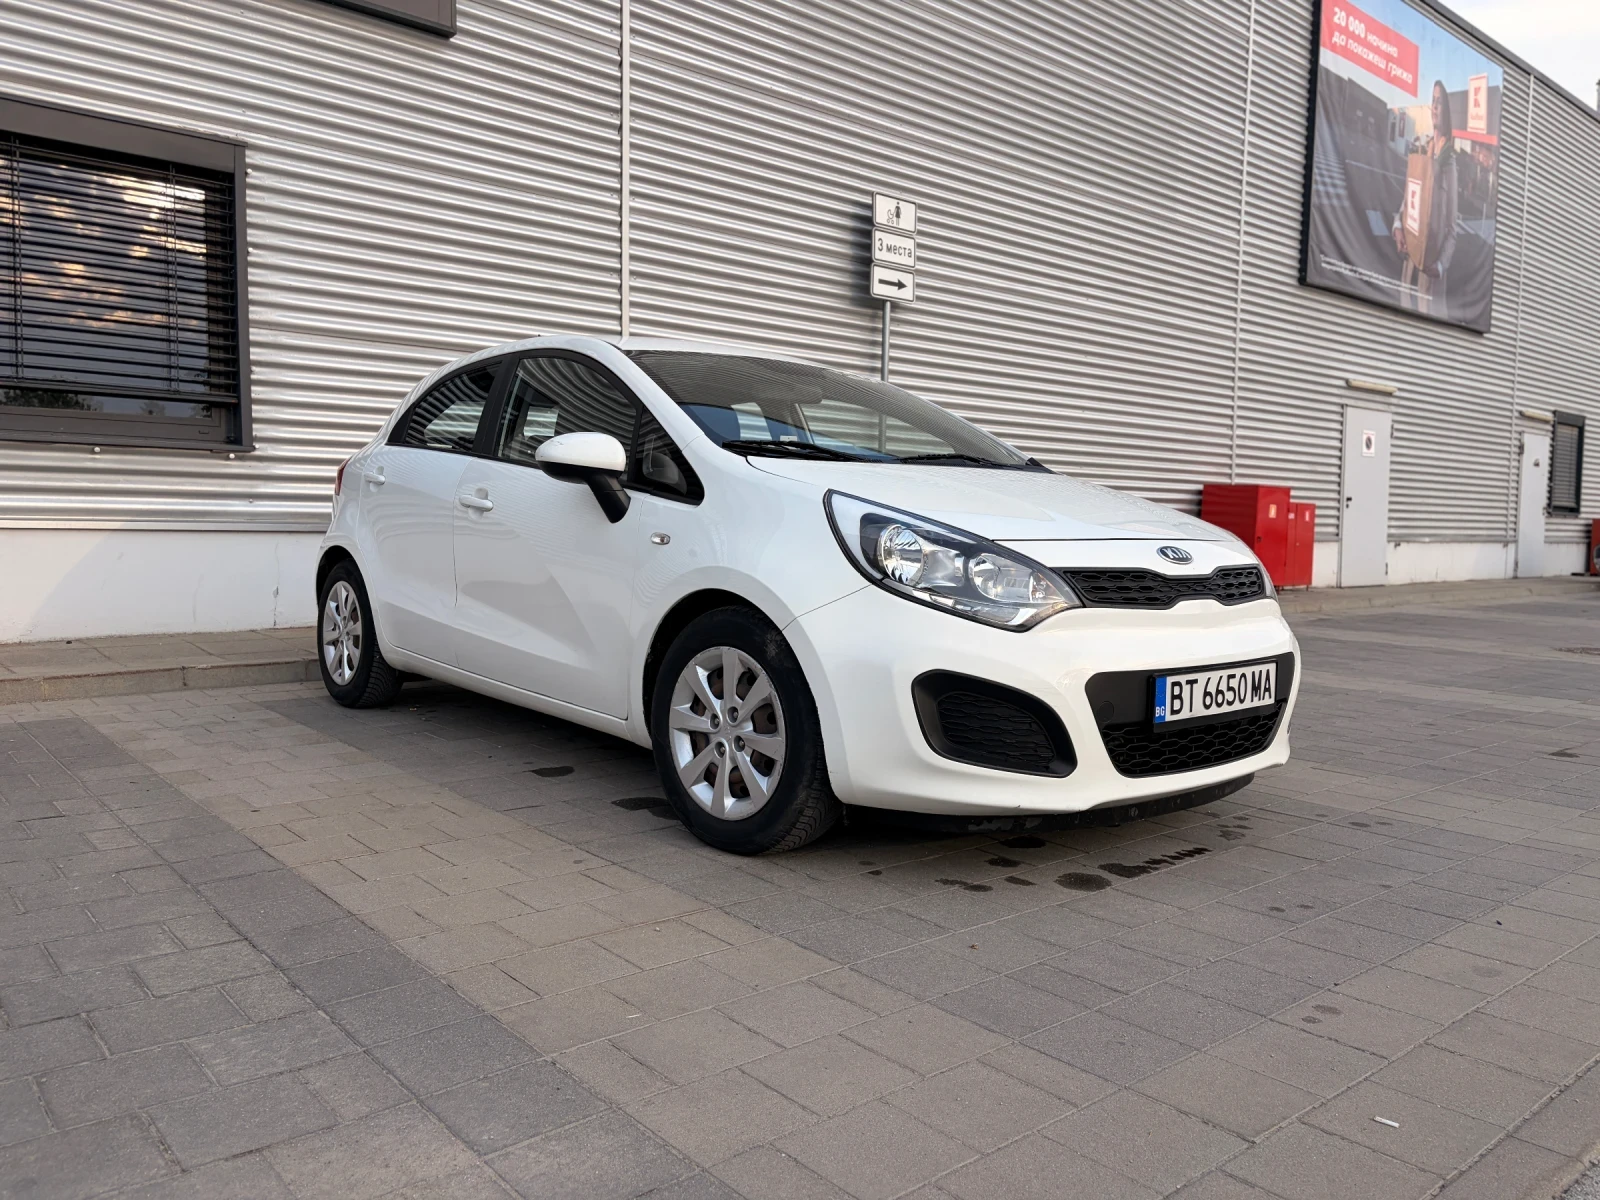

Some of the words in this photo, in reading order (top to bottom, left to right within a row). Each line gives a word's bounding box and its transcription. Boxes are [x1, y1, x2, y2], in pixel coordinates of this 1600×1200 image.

[1333, 7, 1346, 26] 20
[1348, 16, 1365, 38] 000
[1367, 31, 1398, 57] начина
[1332, 31, 1346, 46] да
[1348, 39, 1386, 69] покажеш
[1388, 62, 1412, 84] грижа
[878, 238, 884, 252] 3
[886, 243, 912, 258] места
[1162, 547, 1191, 559] KIA
[1170, 678, 1198, 716] BT
[1203, 672, 1248, 710] 6650
[1250, 668, 1272, 703] MA
[1155, 706, 1165, 717] BG
